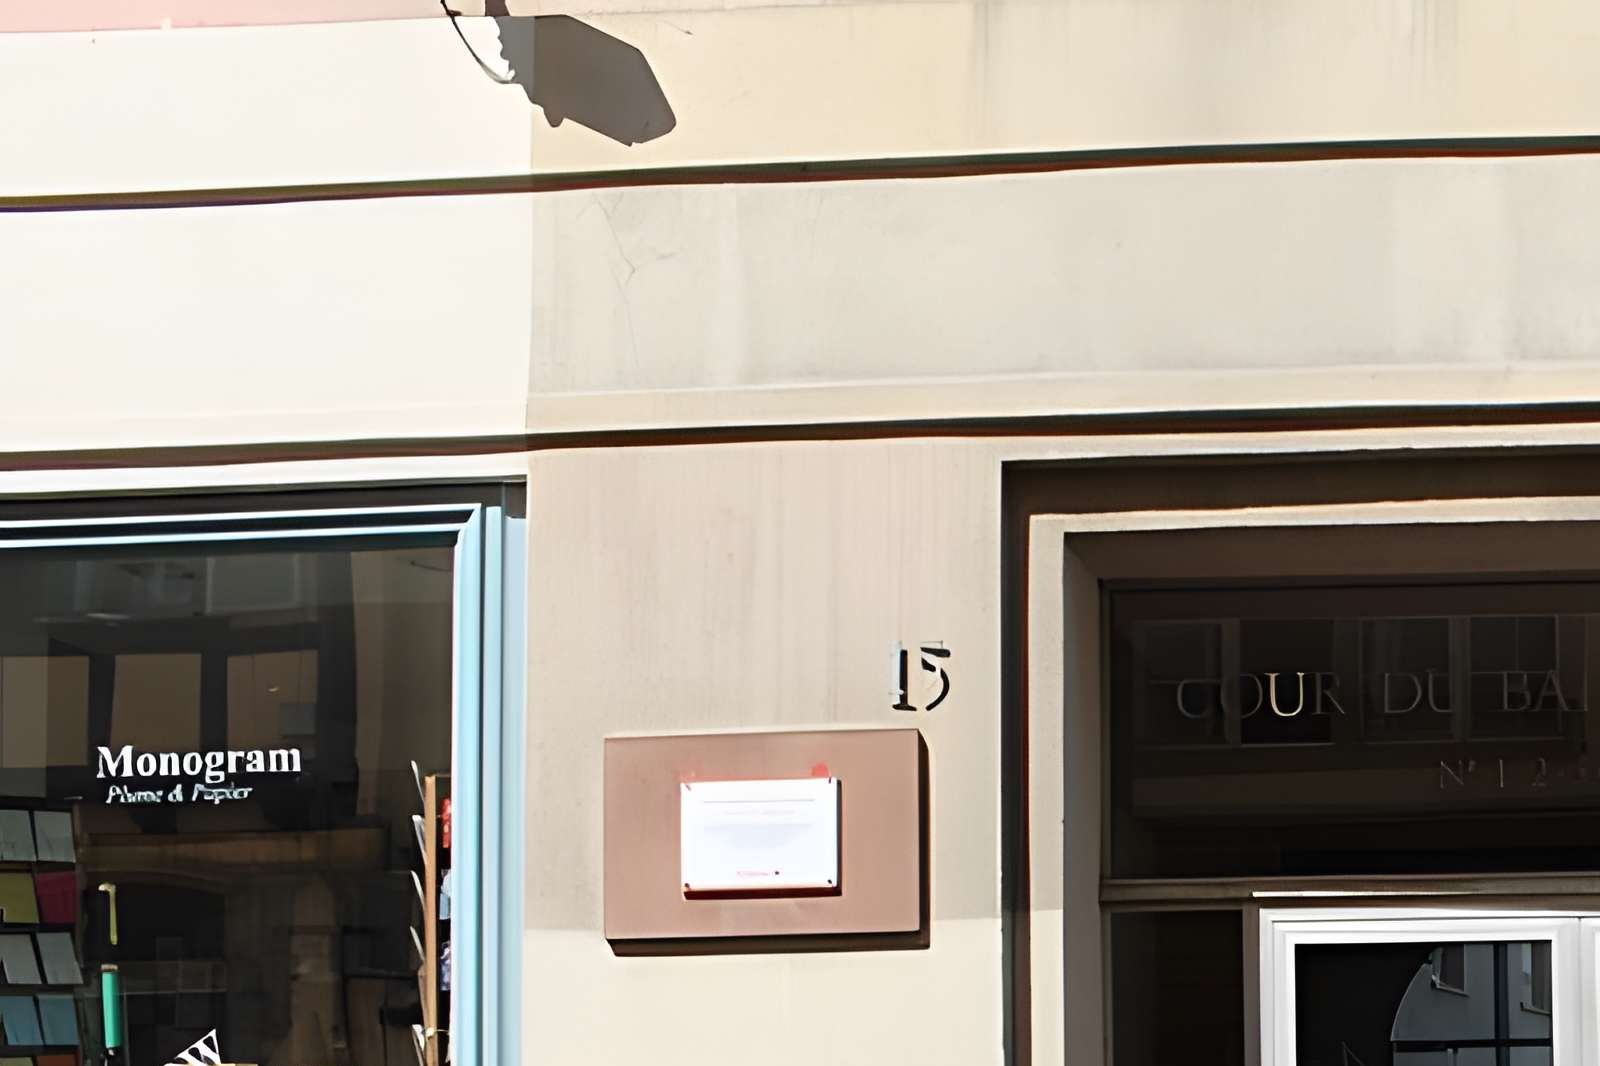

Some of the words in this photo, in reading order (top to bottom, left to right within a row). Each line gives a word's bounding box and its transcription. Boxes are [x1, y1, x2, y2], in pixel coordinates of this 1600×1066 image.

[888, 640, 951, 711] 15
[1176, 672, 1346, 718] COUR
[1381, 668, 1463, 714] DU
[96, 745, 302, 784] Monogram
